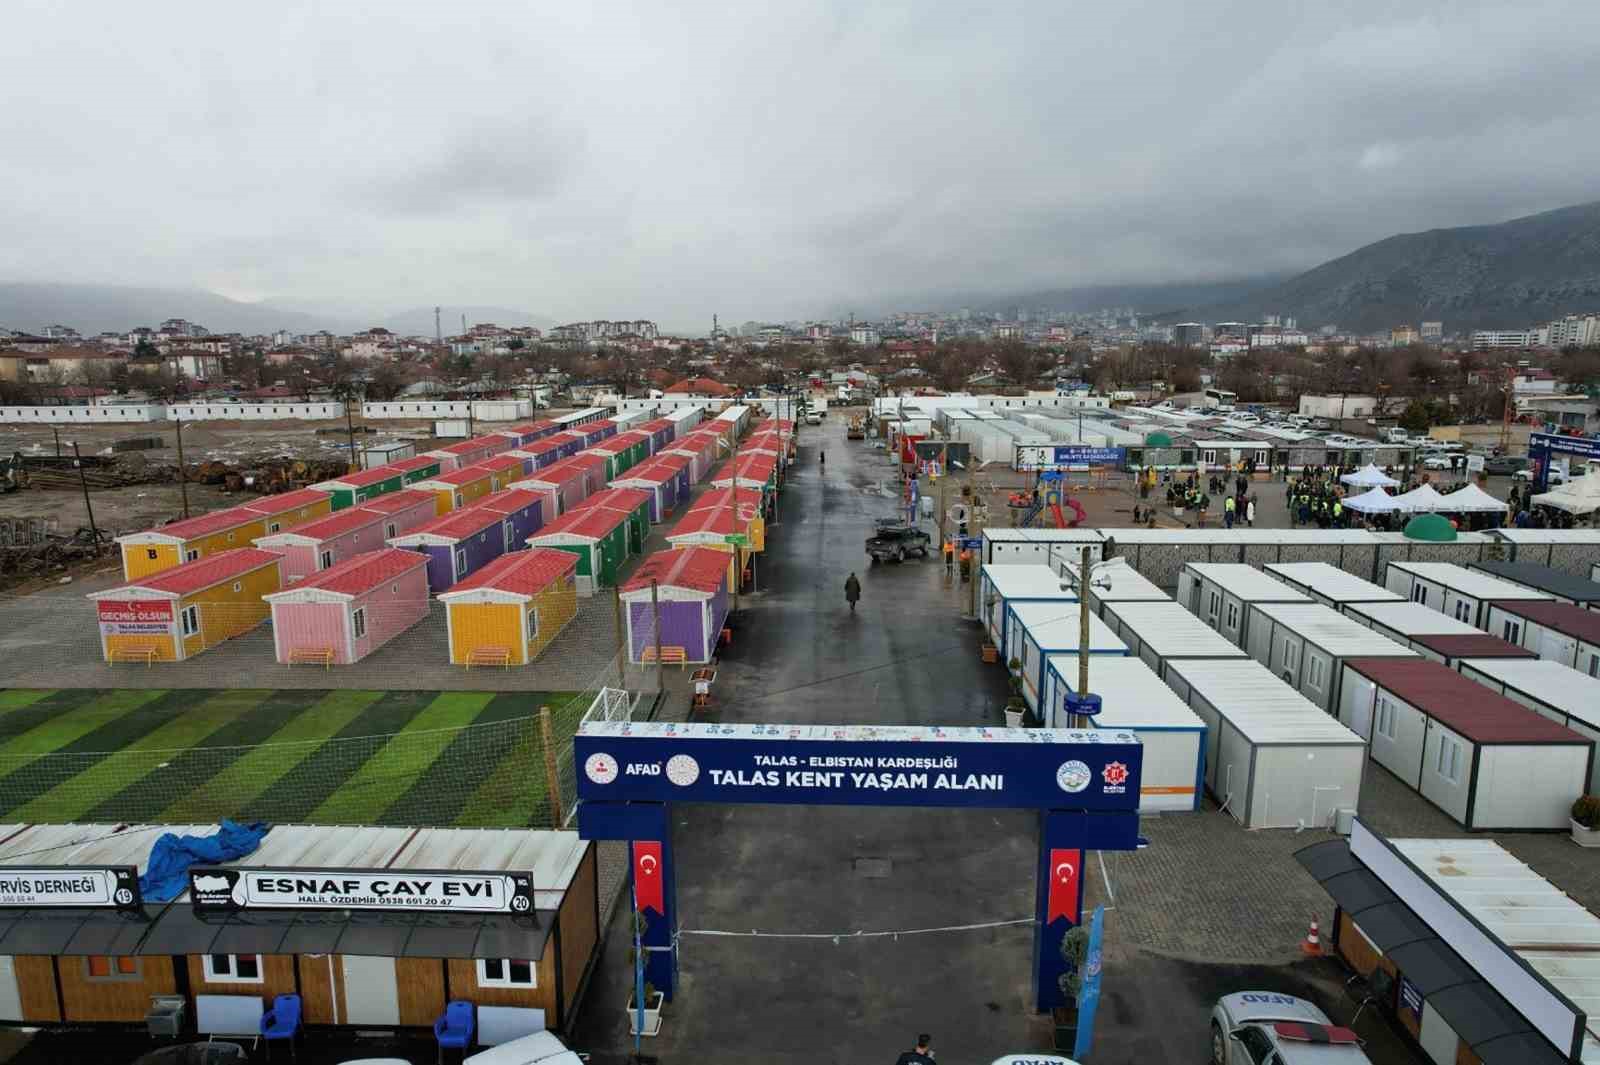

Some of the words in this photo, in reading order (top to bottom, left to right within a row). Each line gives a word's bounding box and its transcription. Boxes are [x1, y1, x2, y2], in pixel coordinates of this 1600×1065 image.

[754, 755, 798, 766] TALAS
[626, 763, 662, 775] AFAD
[709, 770, 780, 786] TALAS
[786, 771, 845, 787] KENT
[851, 772, 928, 791] YAŞAM
[934, 773, 1003, 790] ALANI
[34, 877, 96, 893] DERNEĞİ
[257, 878, 360, 894] ESNAF
[370, 881, 432, 897] ÇAY
[443, 881, 493, 897] EVİ
